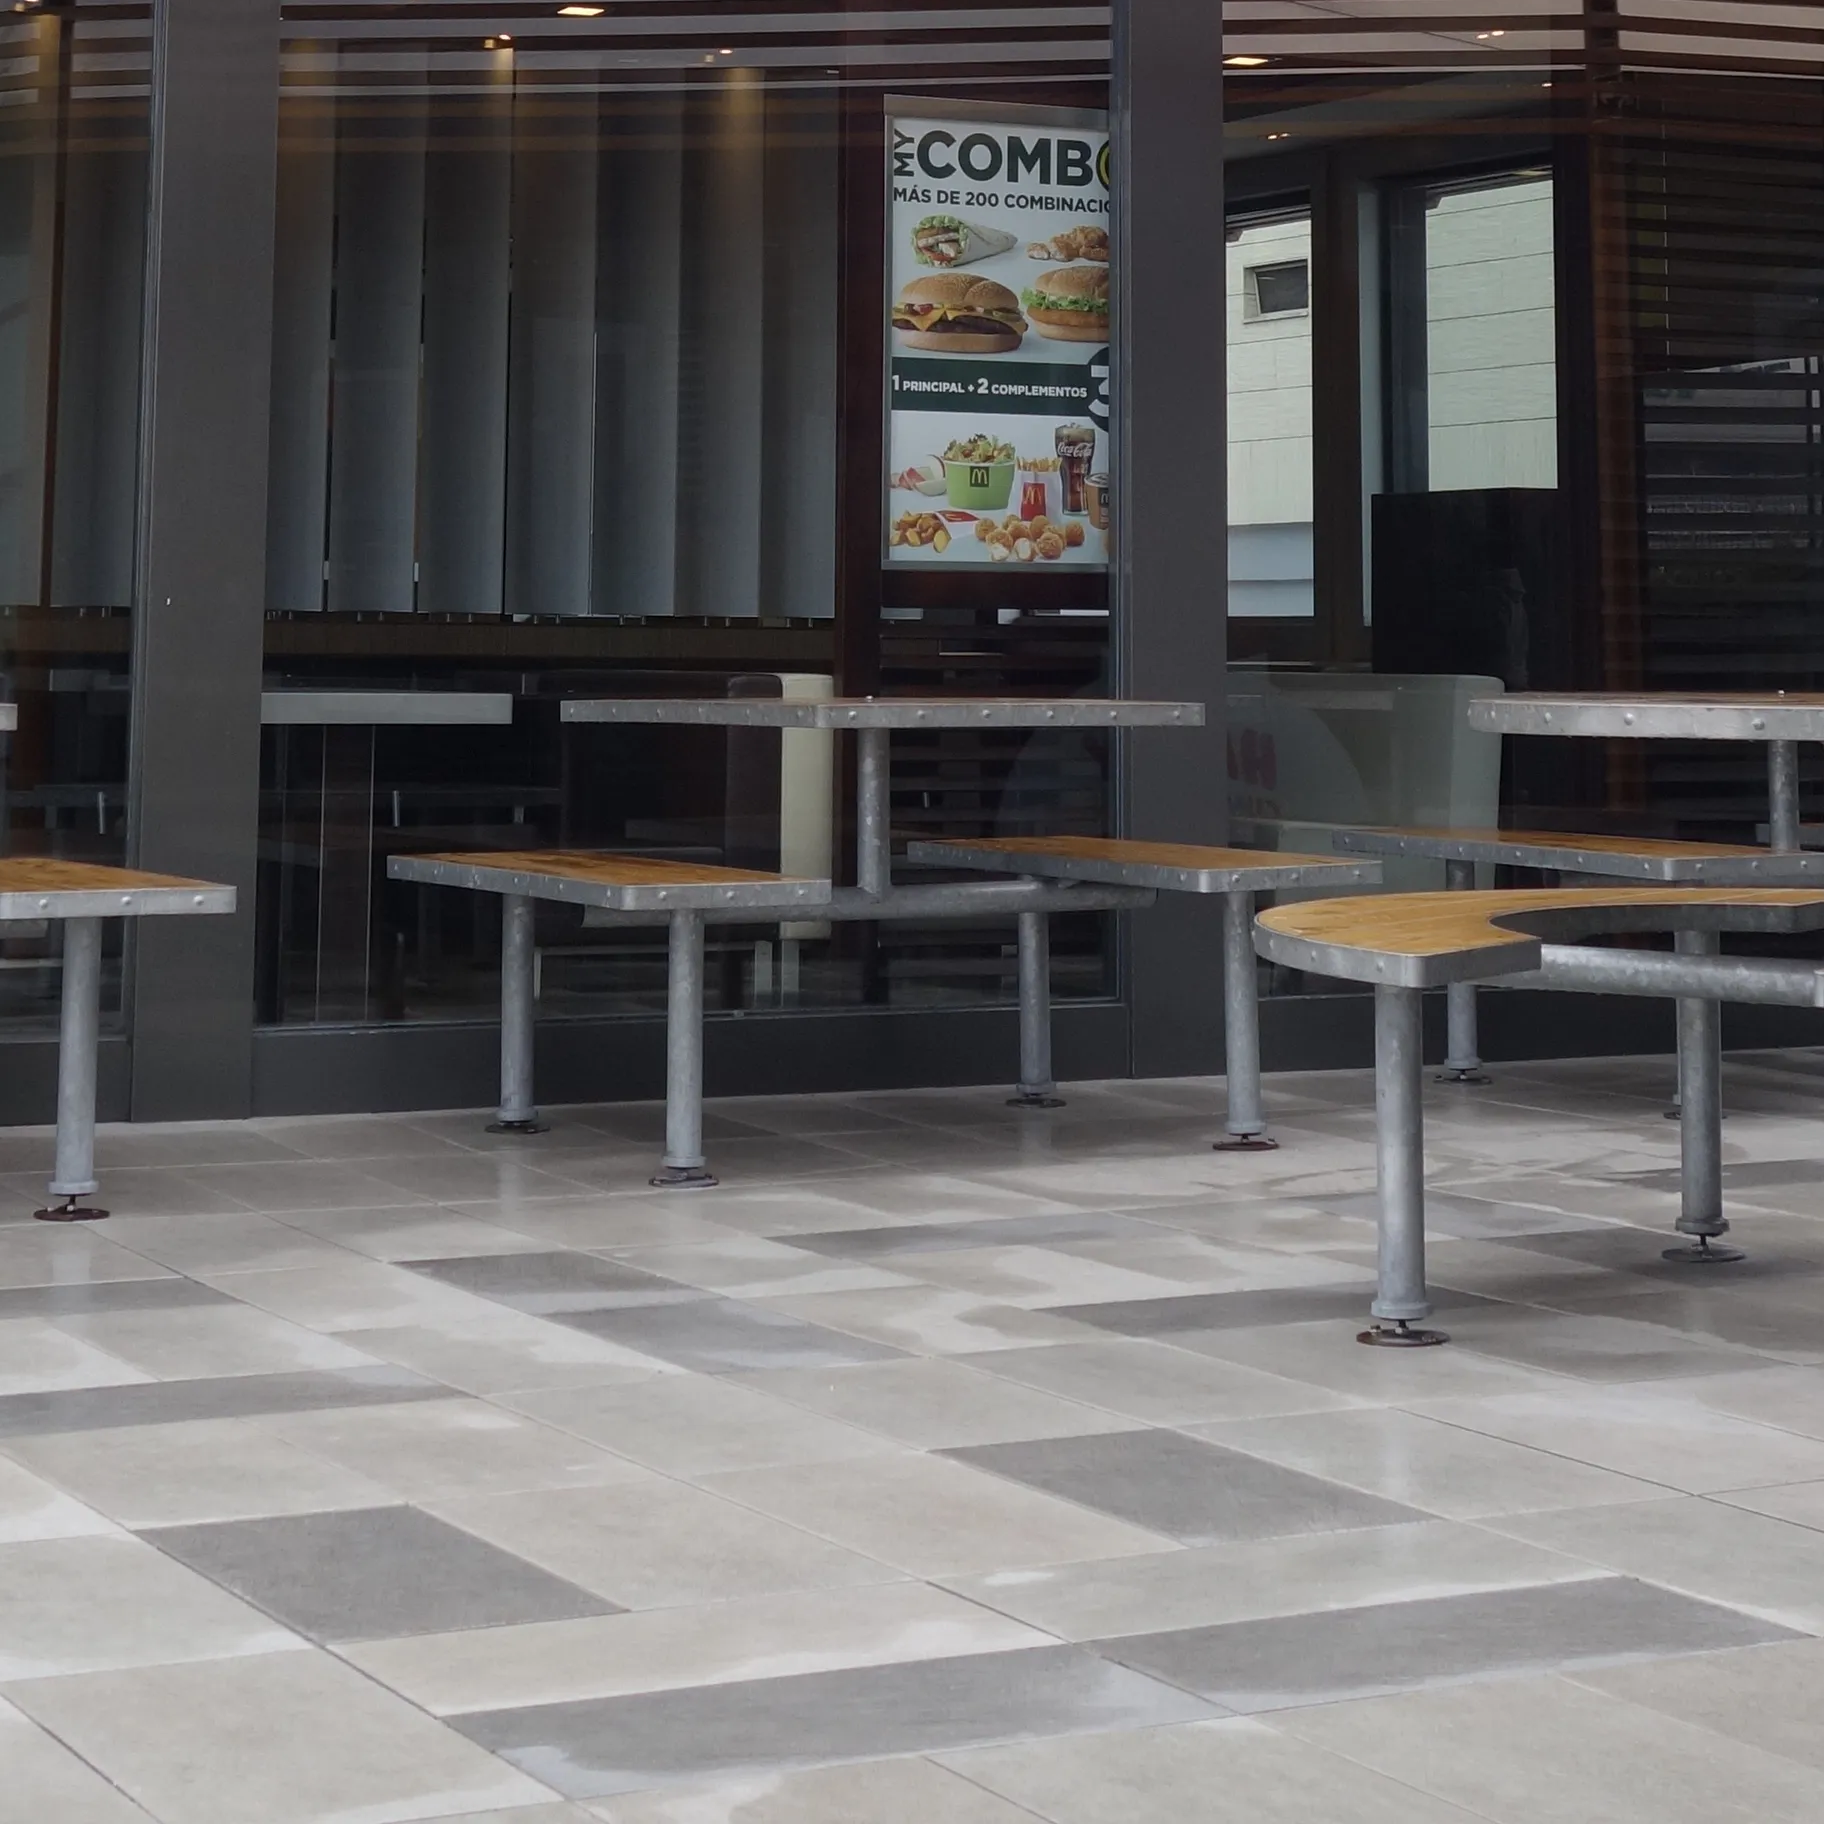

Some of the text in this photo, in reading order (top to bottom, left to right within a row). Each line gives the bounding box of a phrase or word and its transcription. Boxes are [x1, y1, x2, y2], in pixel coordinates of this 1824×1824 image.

[894, 128, 915, 177] MY
[917, 130, 1110, 193] COMB
[894, 184, 932, 203] MÁS
[937, 190, 961, 205] DE
[965, 191, 999, 208] 200
[892, 374, 900, 391] 1
[903, 380, 965, 394] PRINCIPAL
[977, 378, 989, 394] 2
[991, 385, 1088, 398] COMPLEMENTOS
